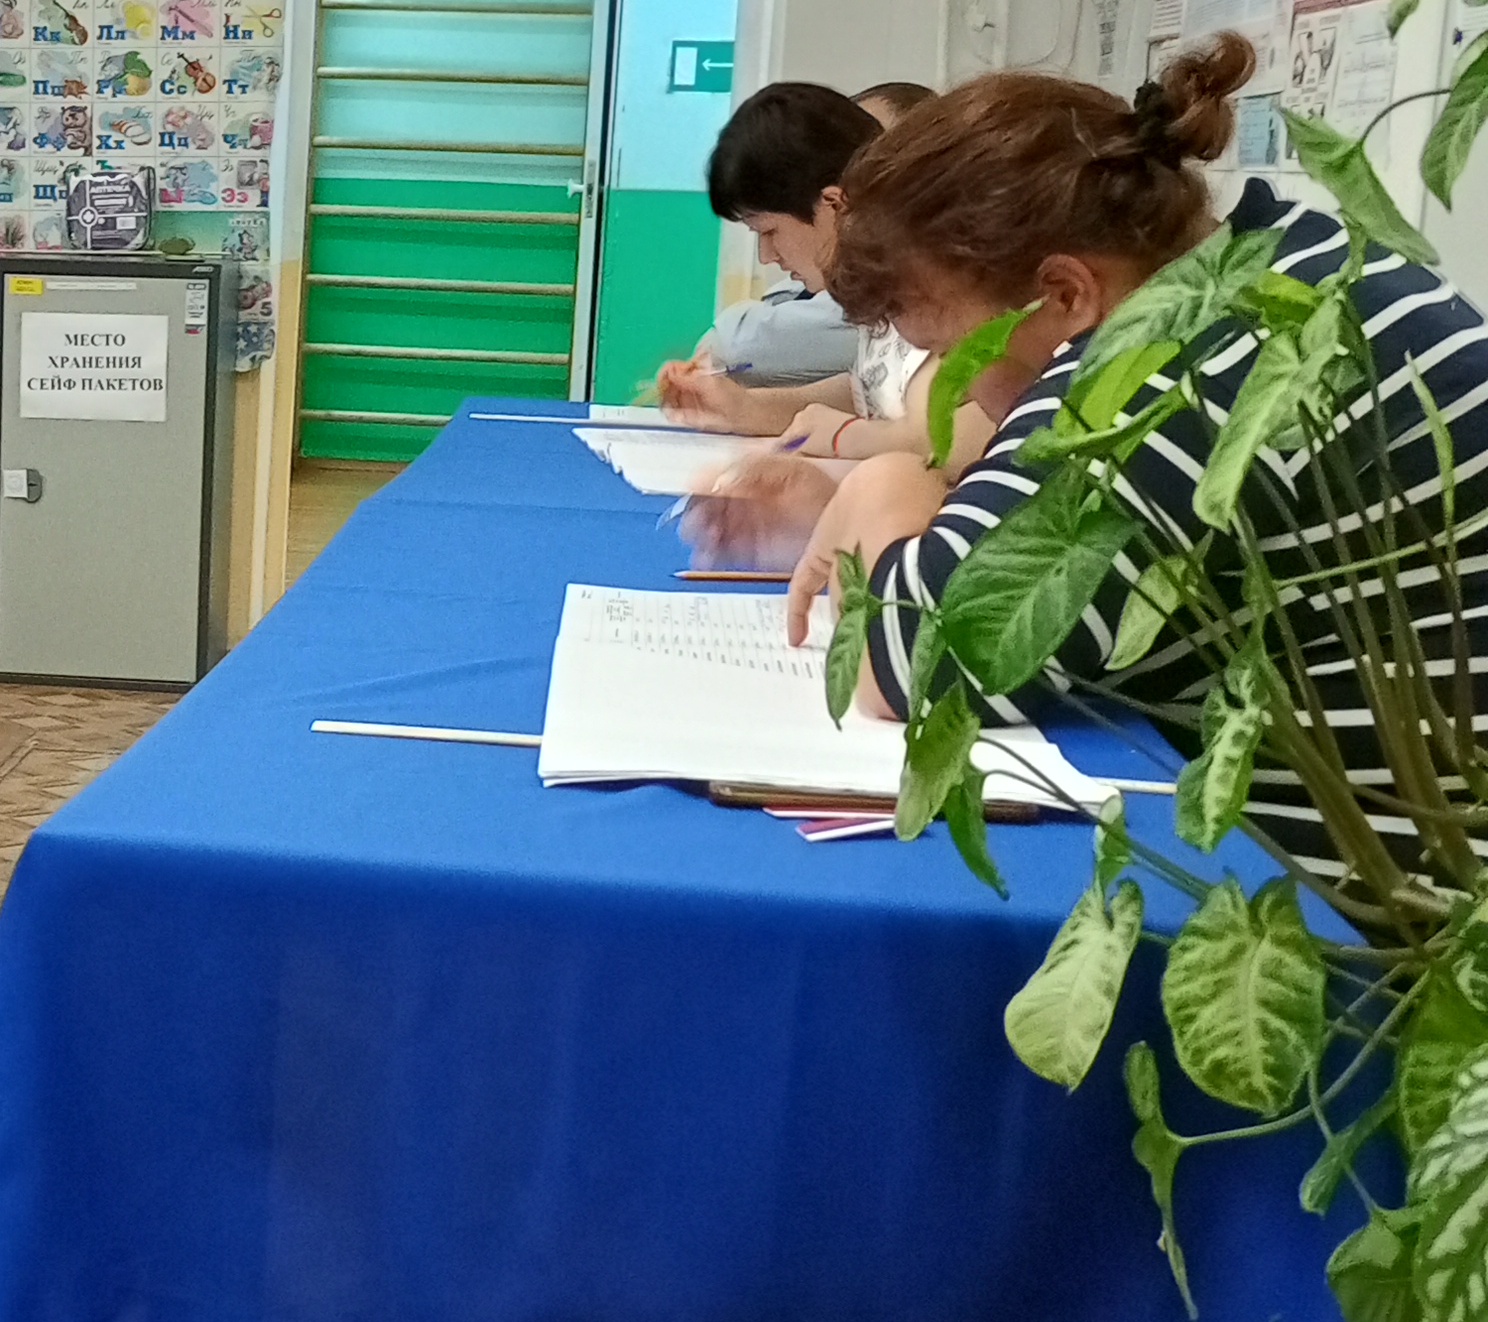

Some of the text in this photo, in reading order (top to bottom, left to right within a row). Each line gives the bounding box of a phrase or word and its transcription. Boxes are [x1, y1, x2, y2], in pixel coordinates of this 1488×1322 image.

[33, 25, 62, 42] Кк
[96, 24, 127, 40] Лл
[160, 25, 197, 40] Мм
[223, 24, 255, 40] Нн
[160, 79, 188, 95] Сс
[222, 79, 250, 95] Тт
[96, 134, 126, 149] Хх
[159, 131, 189, 150] Цц
[221, 187, 249, 203] Ээ
[259, 301, 273, 317] 5
[63, 333, 126, 347] МЕСТО
[47, 355, 142, 369] ХРАНЕНИЯ
[26, 374, 164, 392] СЕЙФ ПАКЕТОВ
